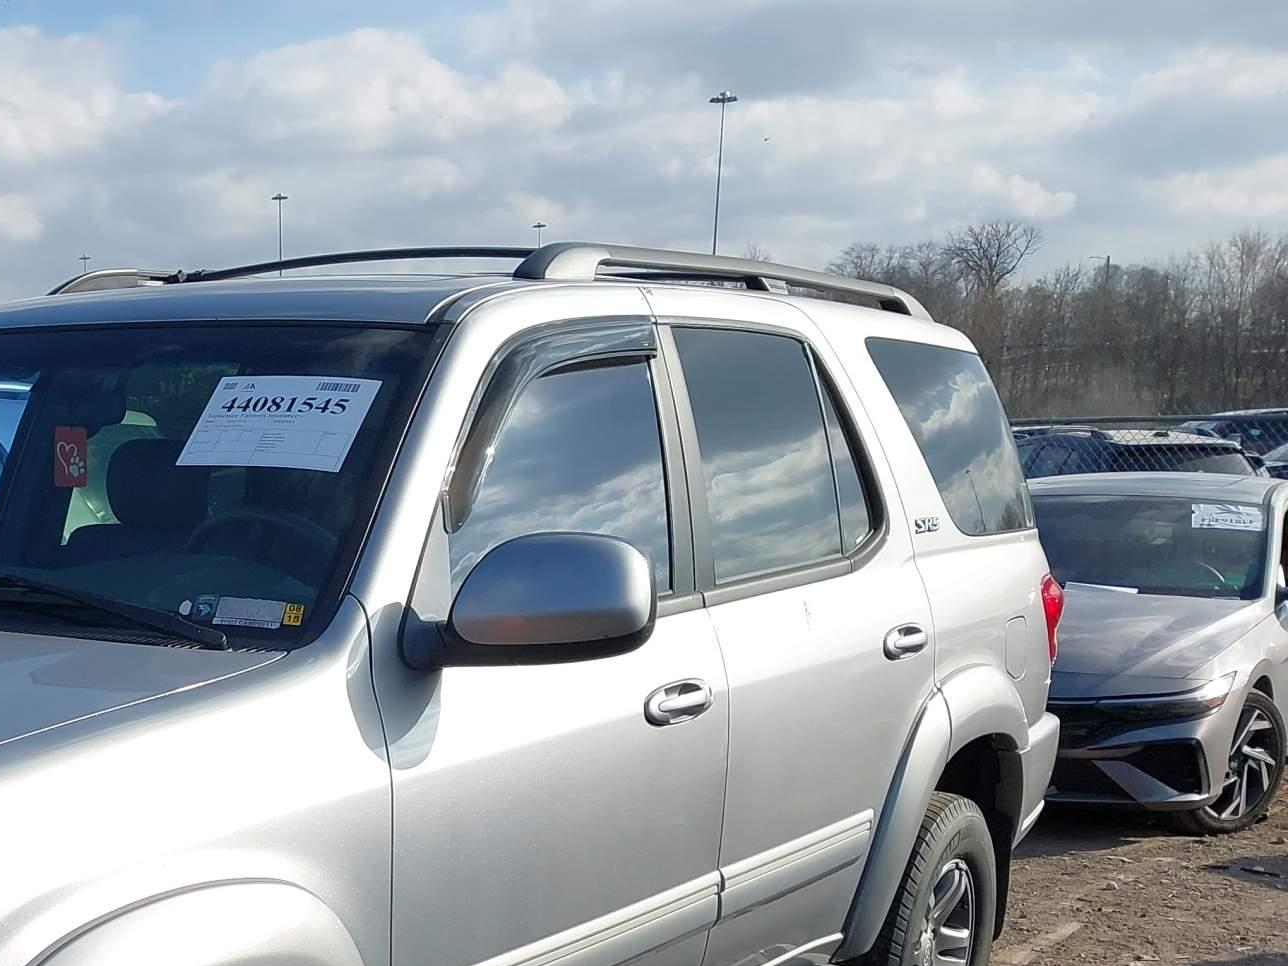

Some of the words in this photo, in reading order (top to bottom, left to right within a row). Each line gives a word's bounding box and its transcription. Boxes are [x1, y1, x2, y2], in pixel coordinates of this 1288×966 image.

[220, 395, 351, 415] 44081545
[914, 516, 939, 534] SR5
[288, 604, 302, 614] 08
